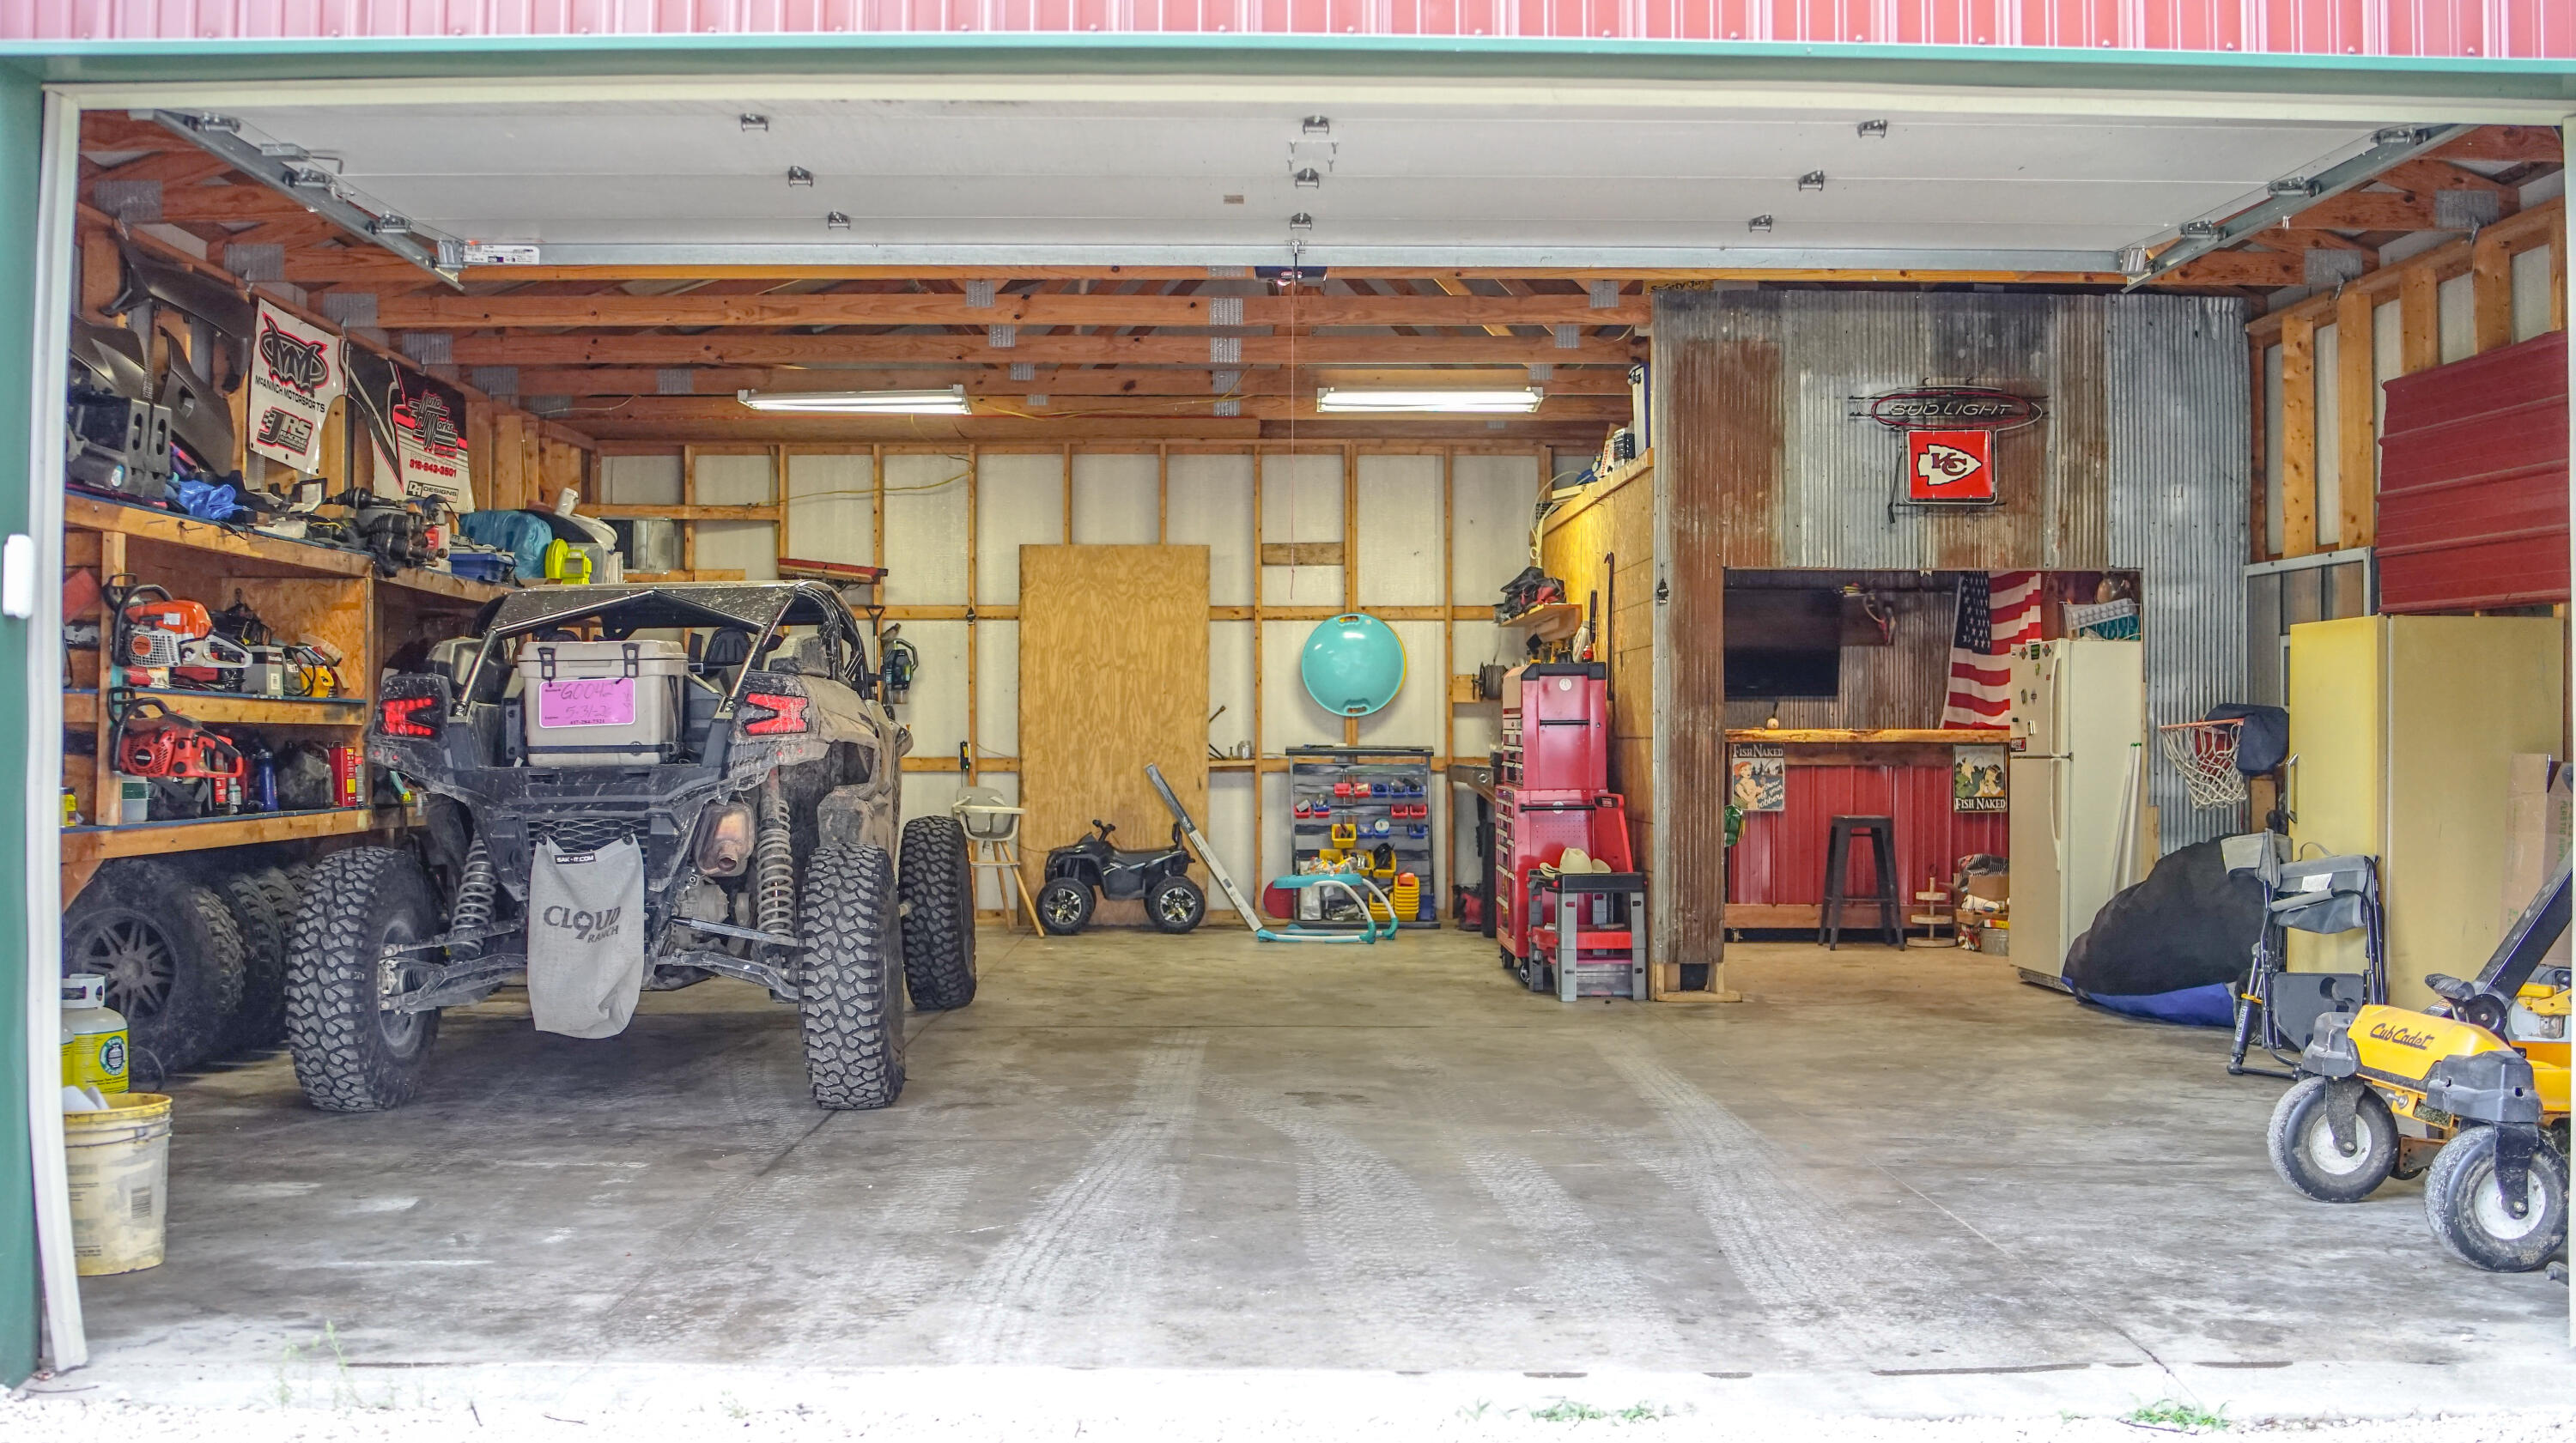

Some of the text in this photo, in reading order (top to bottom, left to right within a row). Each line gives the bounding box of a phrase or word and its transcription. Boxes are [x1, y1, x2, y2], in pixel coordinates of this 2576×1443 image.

[283, 386, 325, 413] MOTORSPORTS
[1889, 402, 2013, 416] BUD LIGHT
[1931, 452, 1967, 476] KC
[423, 486, 458, 497] DESIGNS
[587, 925, 619, 943] RANCH
[2370, 1022, 2435, 1050] Cub Cadet
